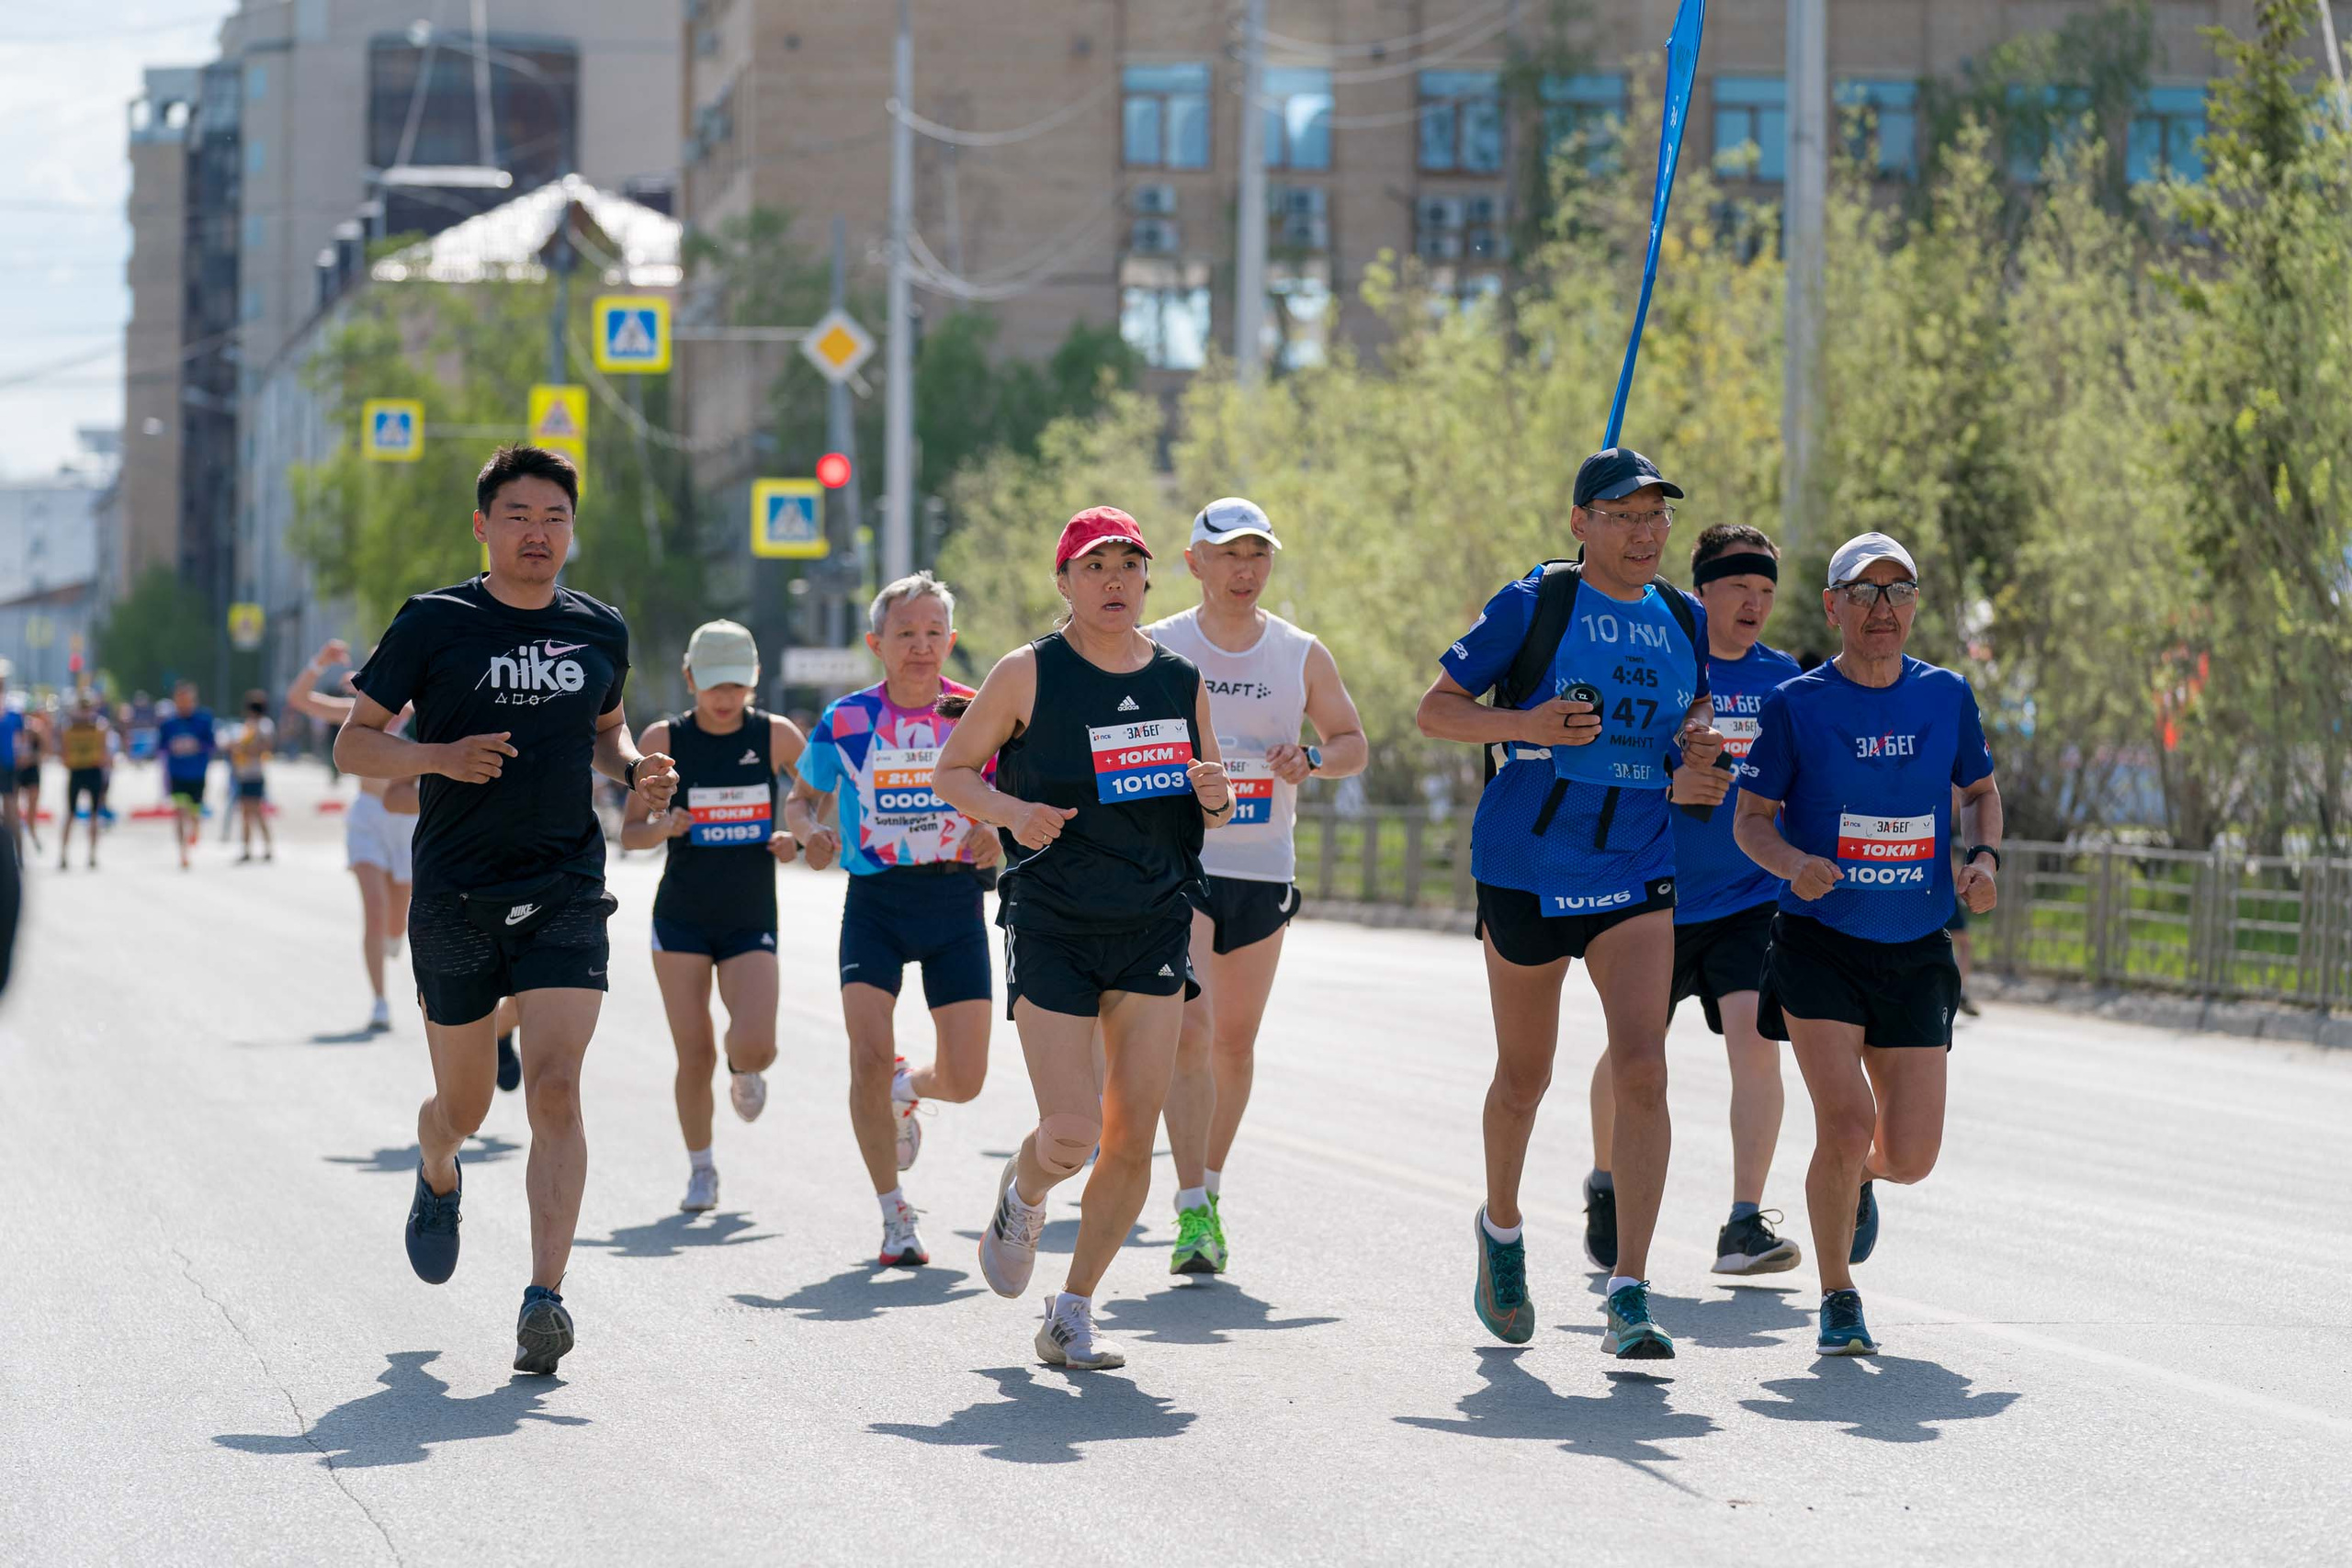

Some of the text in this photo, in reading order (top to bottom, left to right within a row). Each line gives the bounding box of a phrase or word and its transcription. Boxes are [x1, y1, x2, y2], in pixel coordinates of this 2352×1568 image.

[1580, 615, 1619, 643] 10
[491, 646, 584, 692] nike
[1611, 665, 1658, 688] 4:45
[1204, 680, 1254, 696] RAFT
[1611, 697, 1658, 730] 47
[1610, 735, 1654, 749] МИНУТ
[1112, 772, 1185, 795] 10103
[1848, 866, 1924, 885] 10074
[1555, 890, 1631, 909] 10126
[510, 903, 533, 918] NIKE
